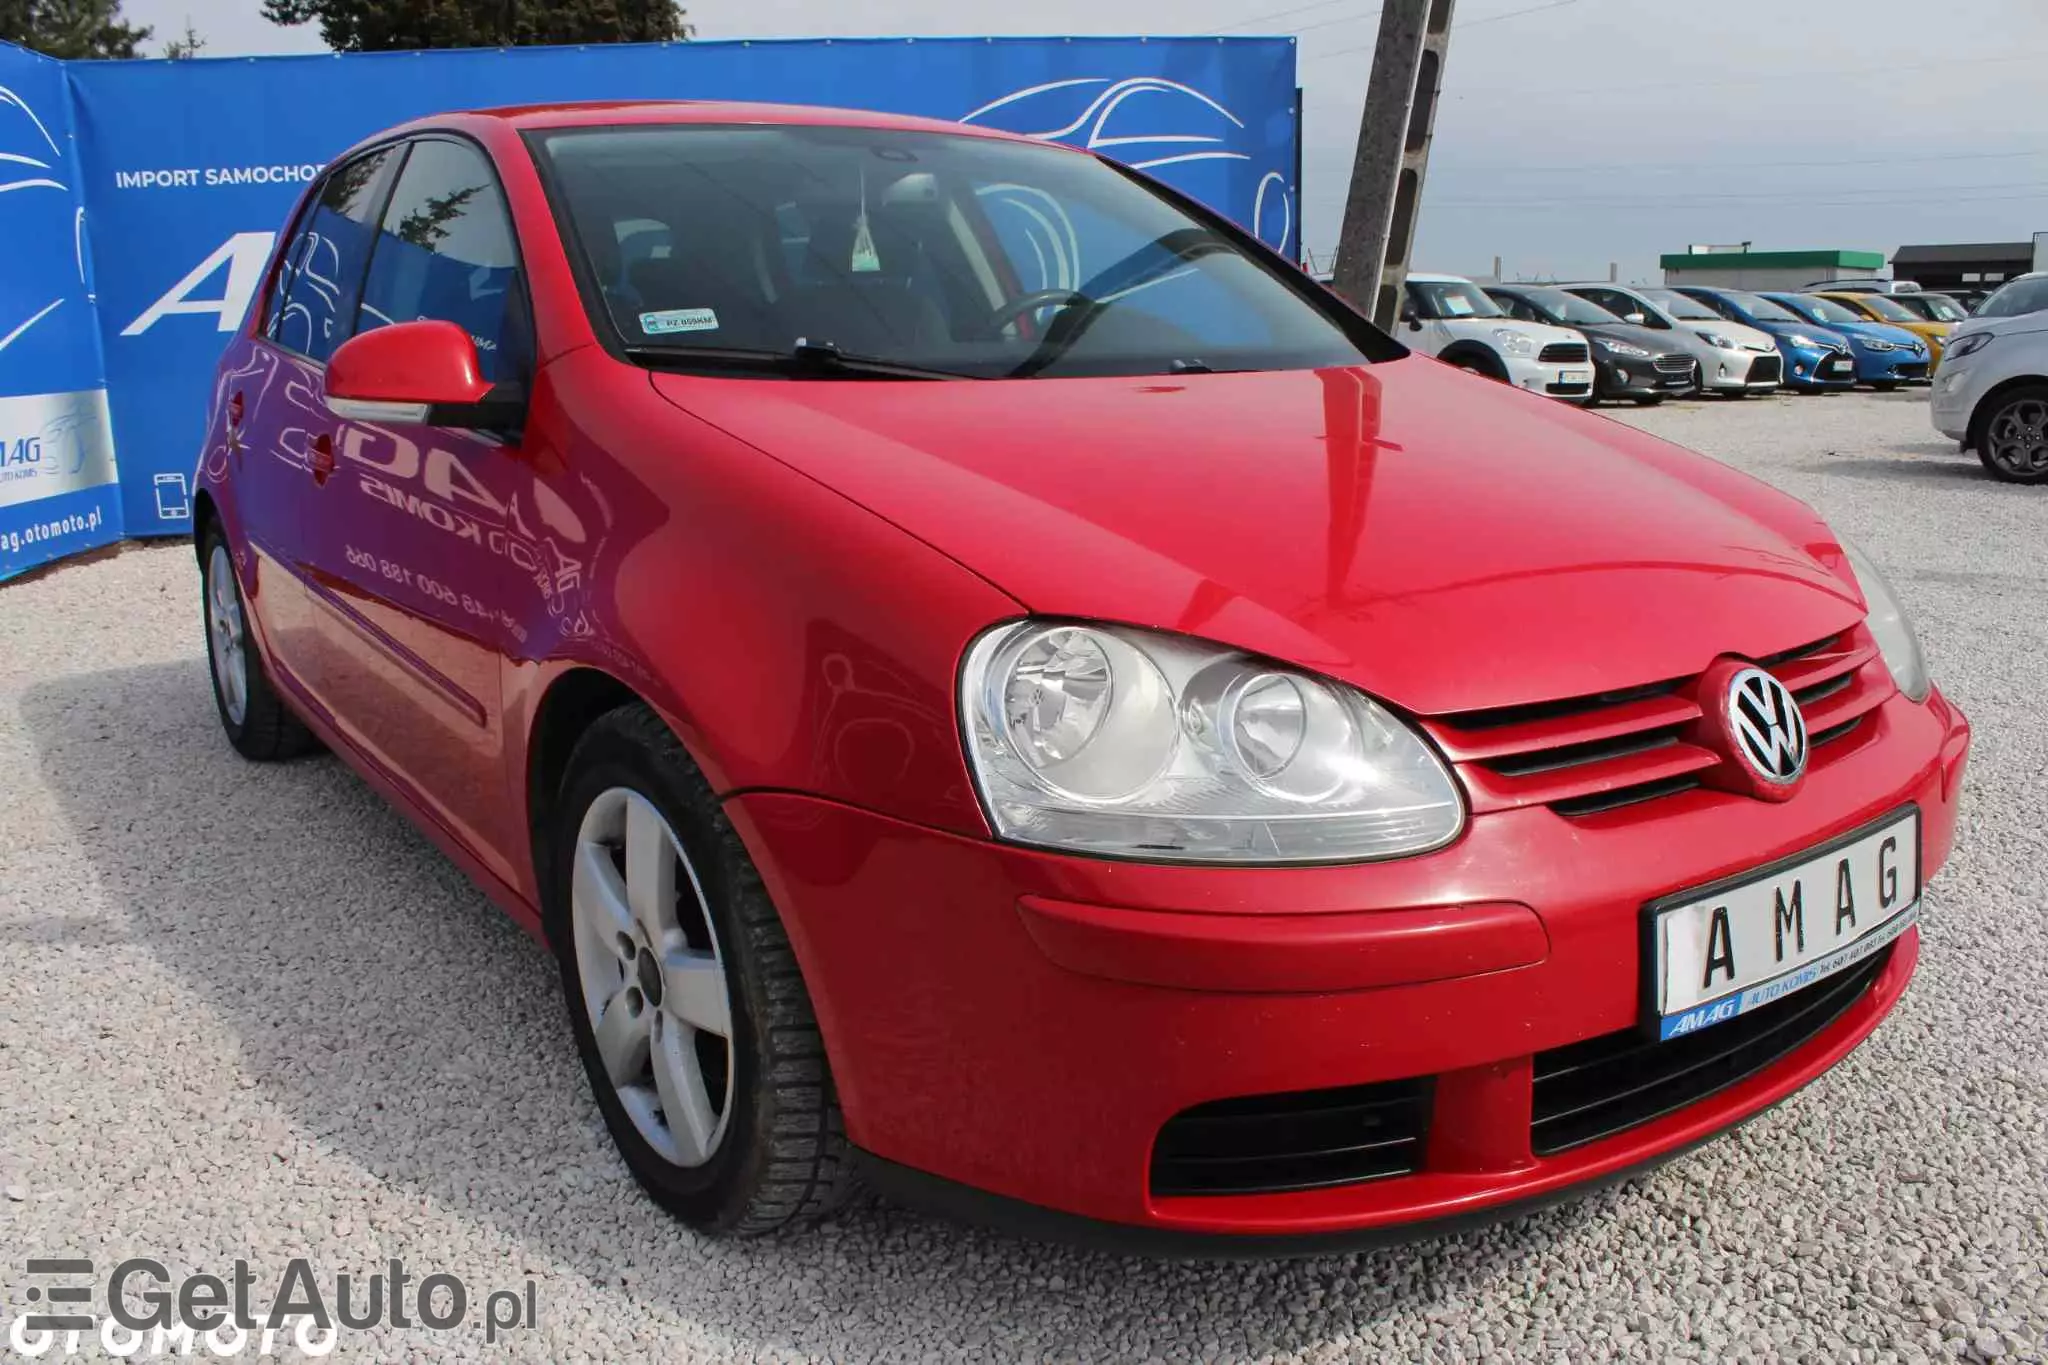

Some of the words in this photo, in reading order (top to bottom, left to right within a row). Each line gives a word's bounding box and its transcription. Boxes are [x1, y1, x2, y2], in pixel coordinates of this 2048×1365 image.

[116, 169, 199, 188] IMPORT
[205, 164, 327, 185] SAMOCHO
[0, 436, 41, 467] AG
[1669, 999, 1736, 1036] AMAG
